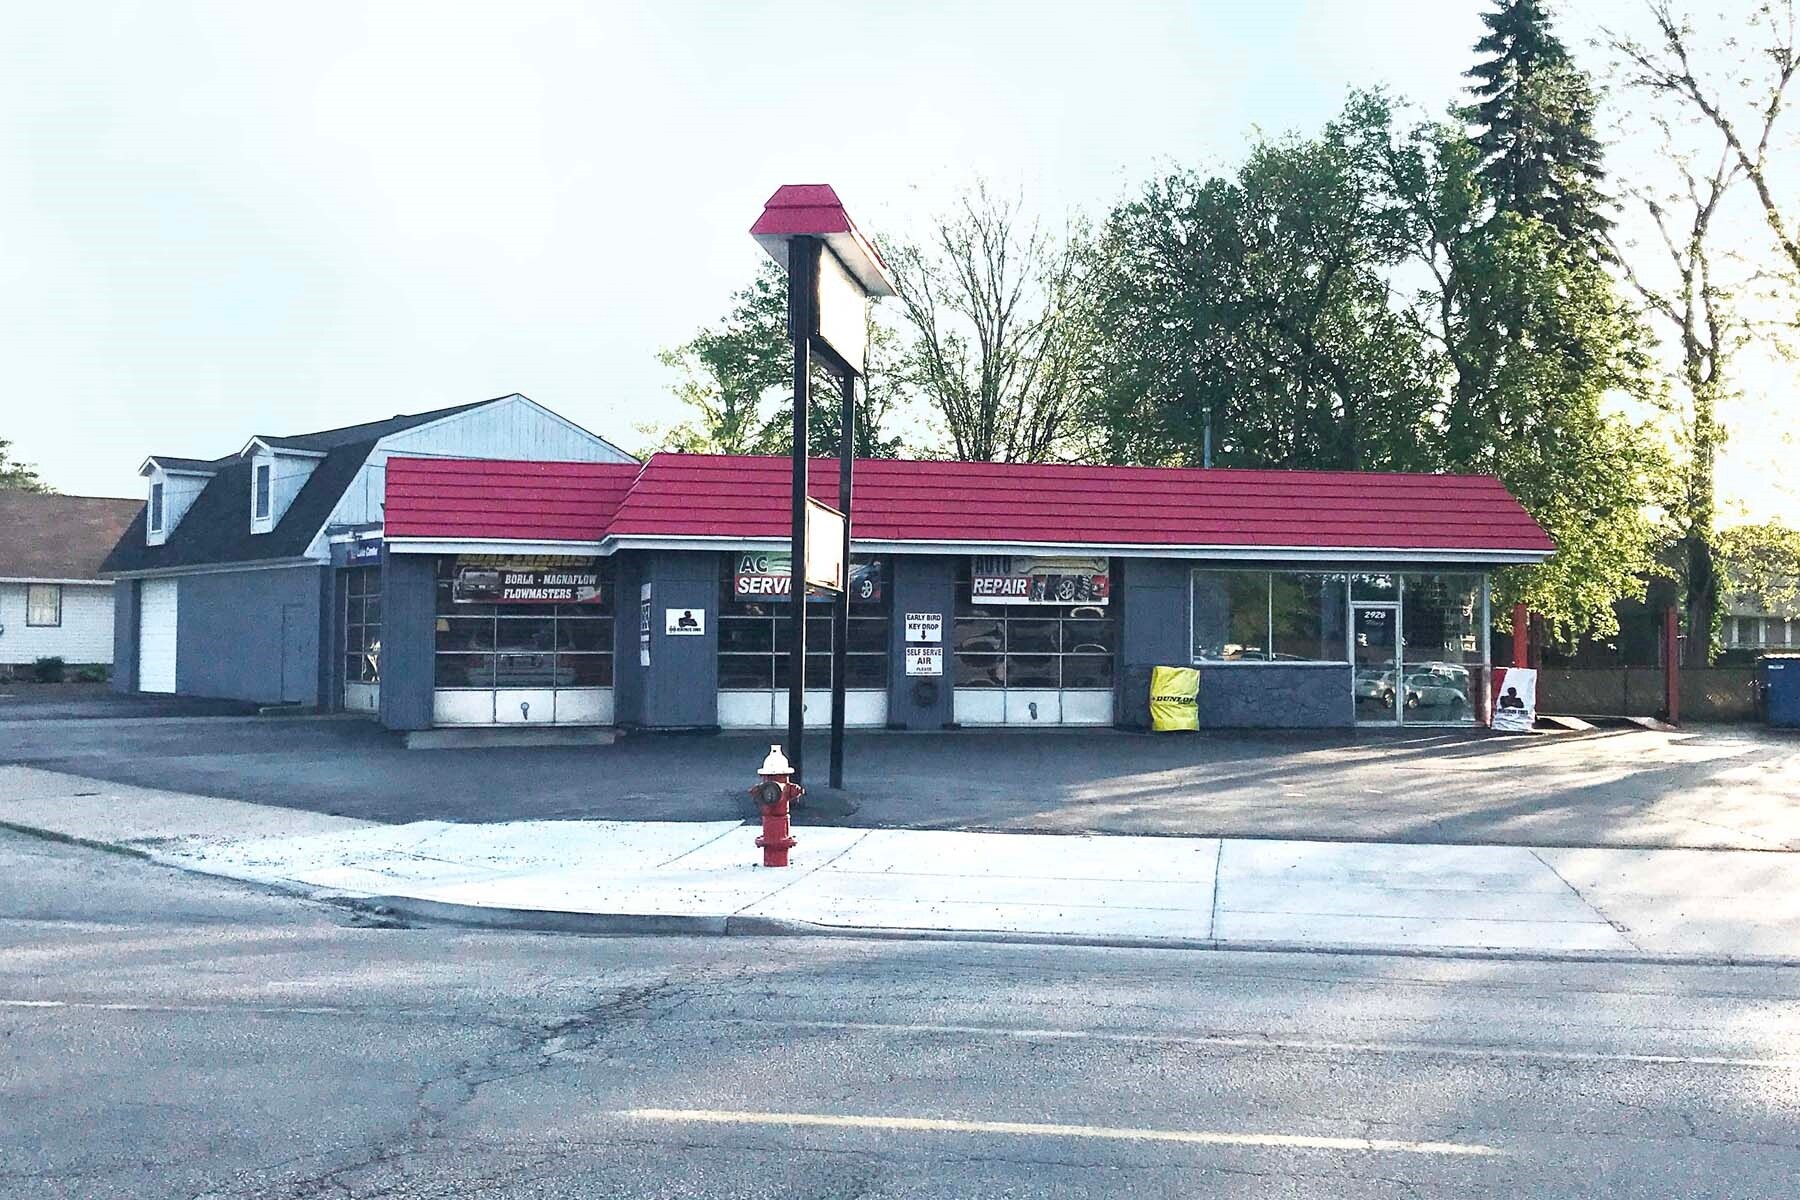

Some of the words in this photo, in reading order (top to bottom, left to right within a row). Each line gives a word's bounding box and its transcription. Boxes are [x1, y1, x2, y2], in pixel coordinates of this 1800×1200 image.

[739, 555, 769, 574] AC
[505, 574, 534, 585] BORLA
[543, 574, 598, 585] MAGNAFLOW
[738, 577, 792, 594] SERVI
[973, 578, 1027, 594] REPAIR
[504, 588, 572, 599] FLOWMASTERS
[907, 648, 922, 656] SELF
[922, 648, 942, 656] SERVE
[917, 656, 932, 665] AIR
